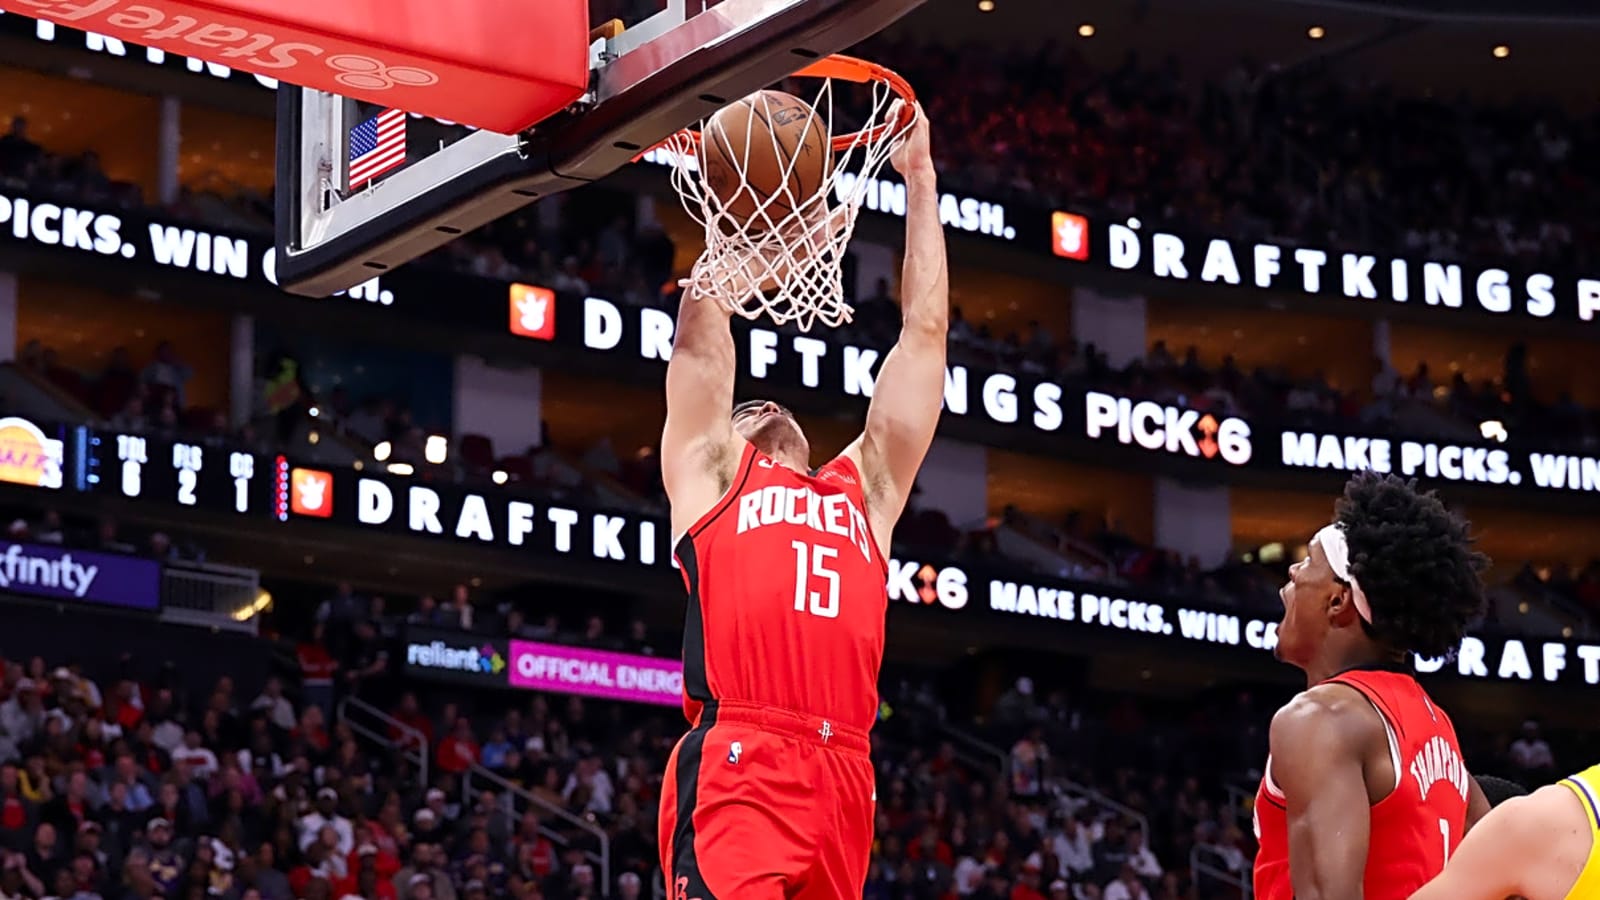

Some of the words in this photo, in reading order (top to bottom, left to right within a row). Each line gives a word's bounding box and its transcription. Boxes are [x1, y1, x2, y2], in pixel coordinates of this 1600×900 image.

[149, 224, 248, 278] WIN
[836, 171, 906, 216] WIN
[935, 192, 1016, 240] ASH.
[1109, 224, 1555, 317] DRAFTKINGS
[584, 298, 1063, 431] DRFTKNGS
[1282, 432, 1390, 472] MAKE
[1401, 442, 1522, 485] PICKS.
[1529, 452, 1600, 492] WIN
[178, 470, 197, 505] 2
[235, 478, 249, 512] 1
[736, 485, 872, 564] ROCKETS
[791, 539, 841, 619] 15
[990, 580, 1075, 621] MAKE
[1081, 594, 1173, 635] PICKS.
[1177, 609, 1240, 645] WIN
[1245, 619, 1280, 650] CA
[407, 642, 480, 672] reliant
[517, 653, 613, 687] OFFICIAL
[1409, 736, 1469, 802] THOMPSON
